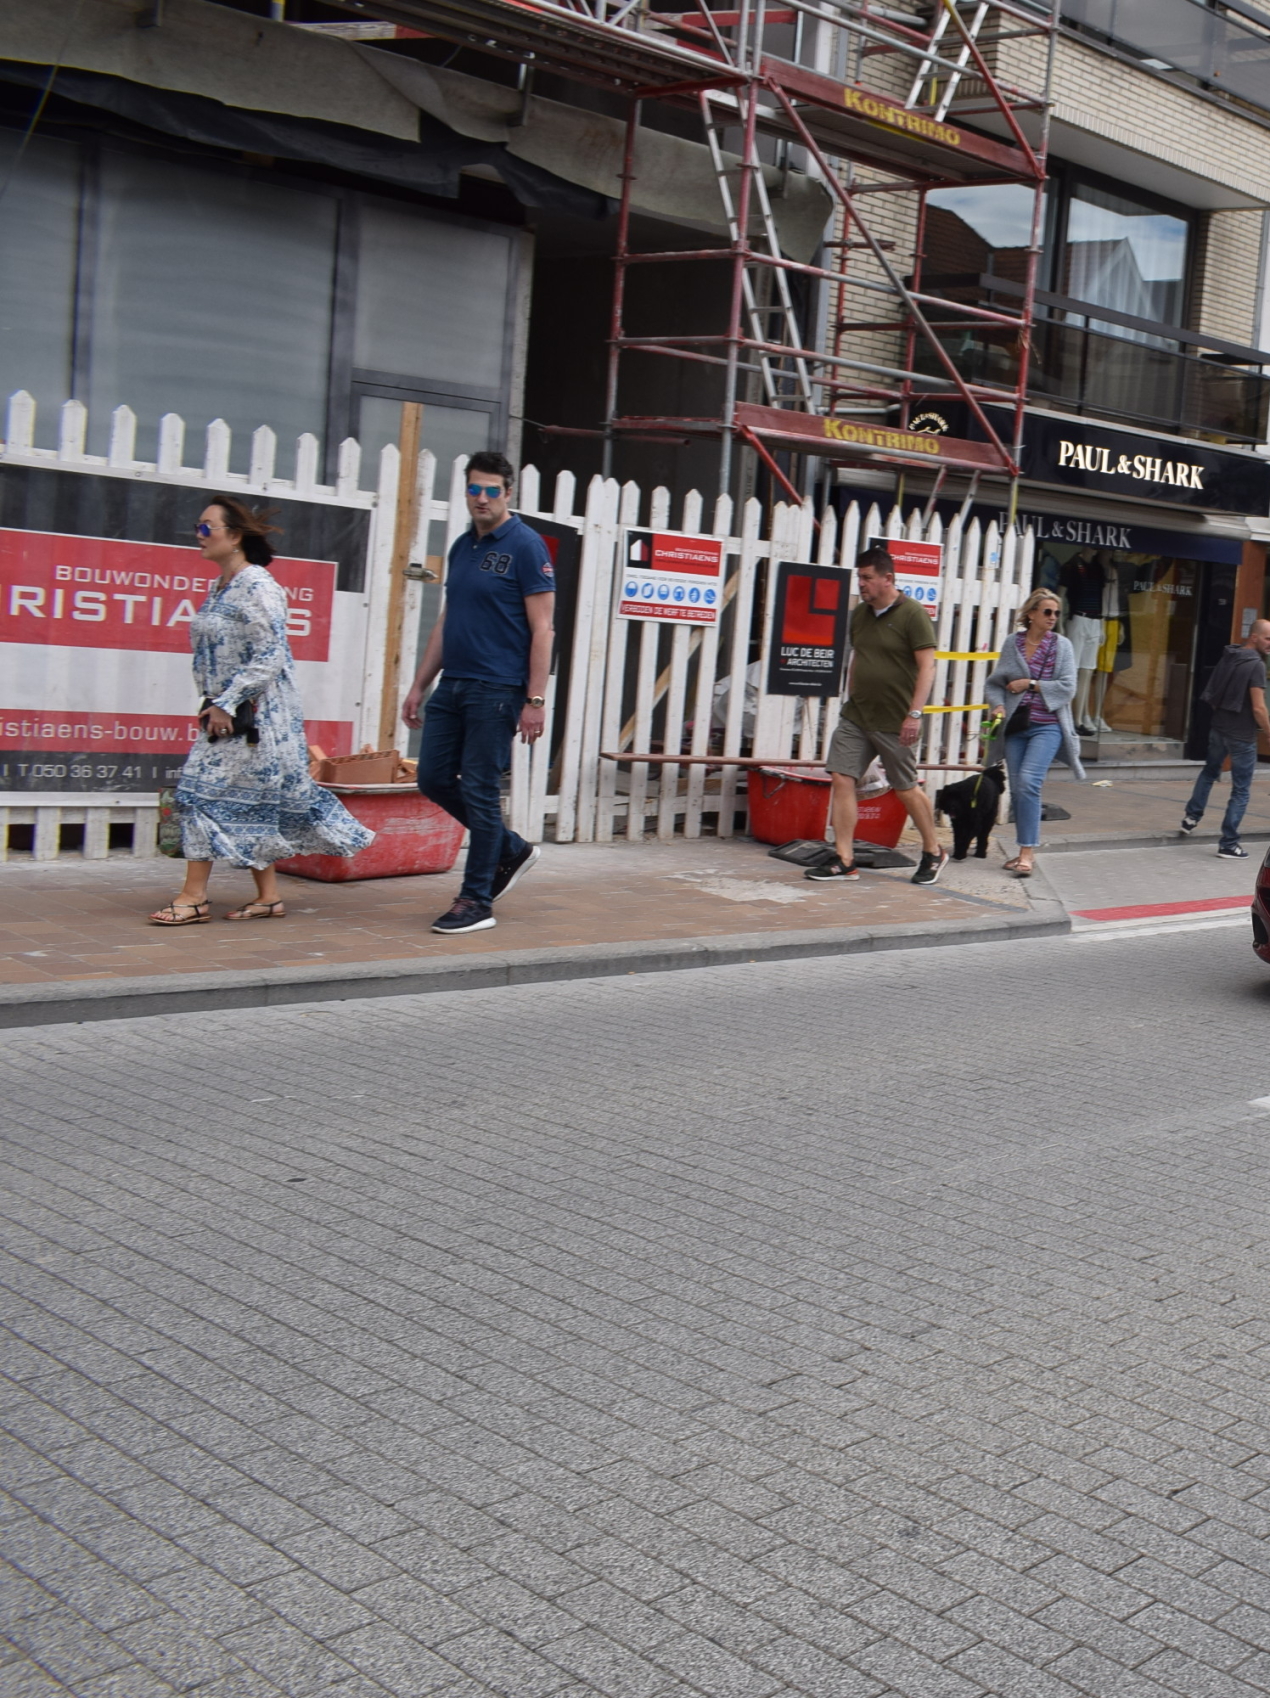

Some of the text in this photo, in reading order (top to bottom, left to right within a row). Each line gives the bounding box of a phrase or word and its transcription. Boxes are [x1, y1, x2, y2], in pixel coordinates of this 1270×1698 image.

[844, 87, 960, 145] KONTRIMO
[823, 418, 940, 454] KONTRIMO
[1066, 520, 1132, 549] SHARK
[480, 551, 513, 575] 68
[655, 549, 719, 563] CHRISTIAENS
[55, 565, 314, 602] BOUWONDENG
[781, 646, 799, 657] LUC
[800, 647, 813, 658] DE
[0, 716, 200, 742] istiaens-bouw.b
[70, 765, 92, 778] 36
[96, 766, 118, 779] 37
[122, 766, 142, 779] 41
